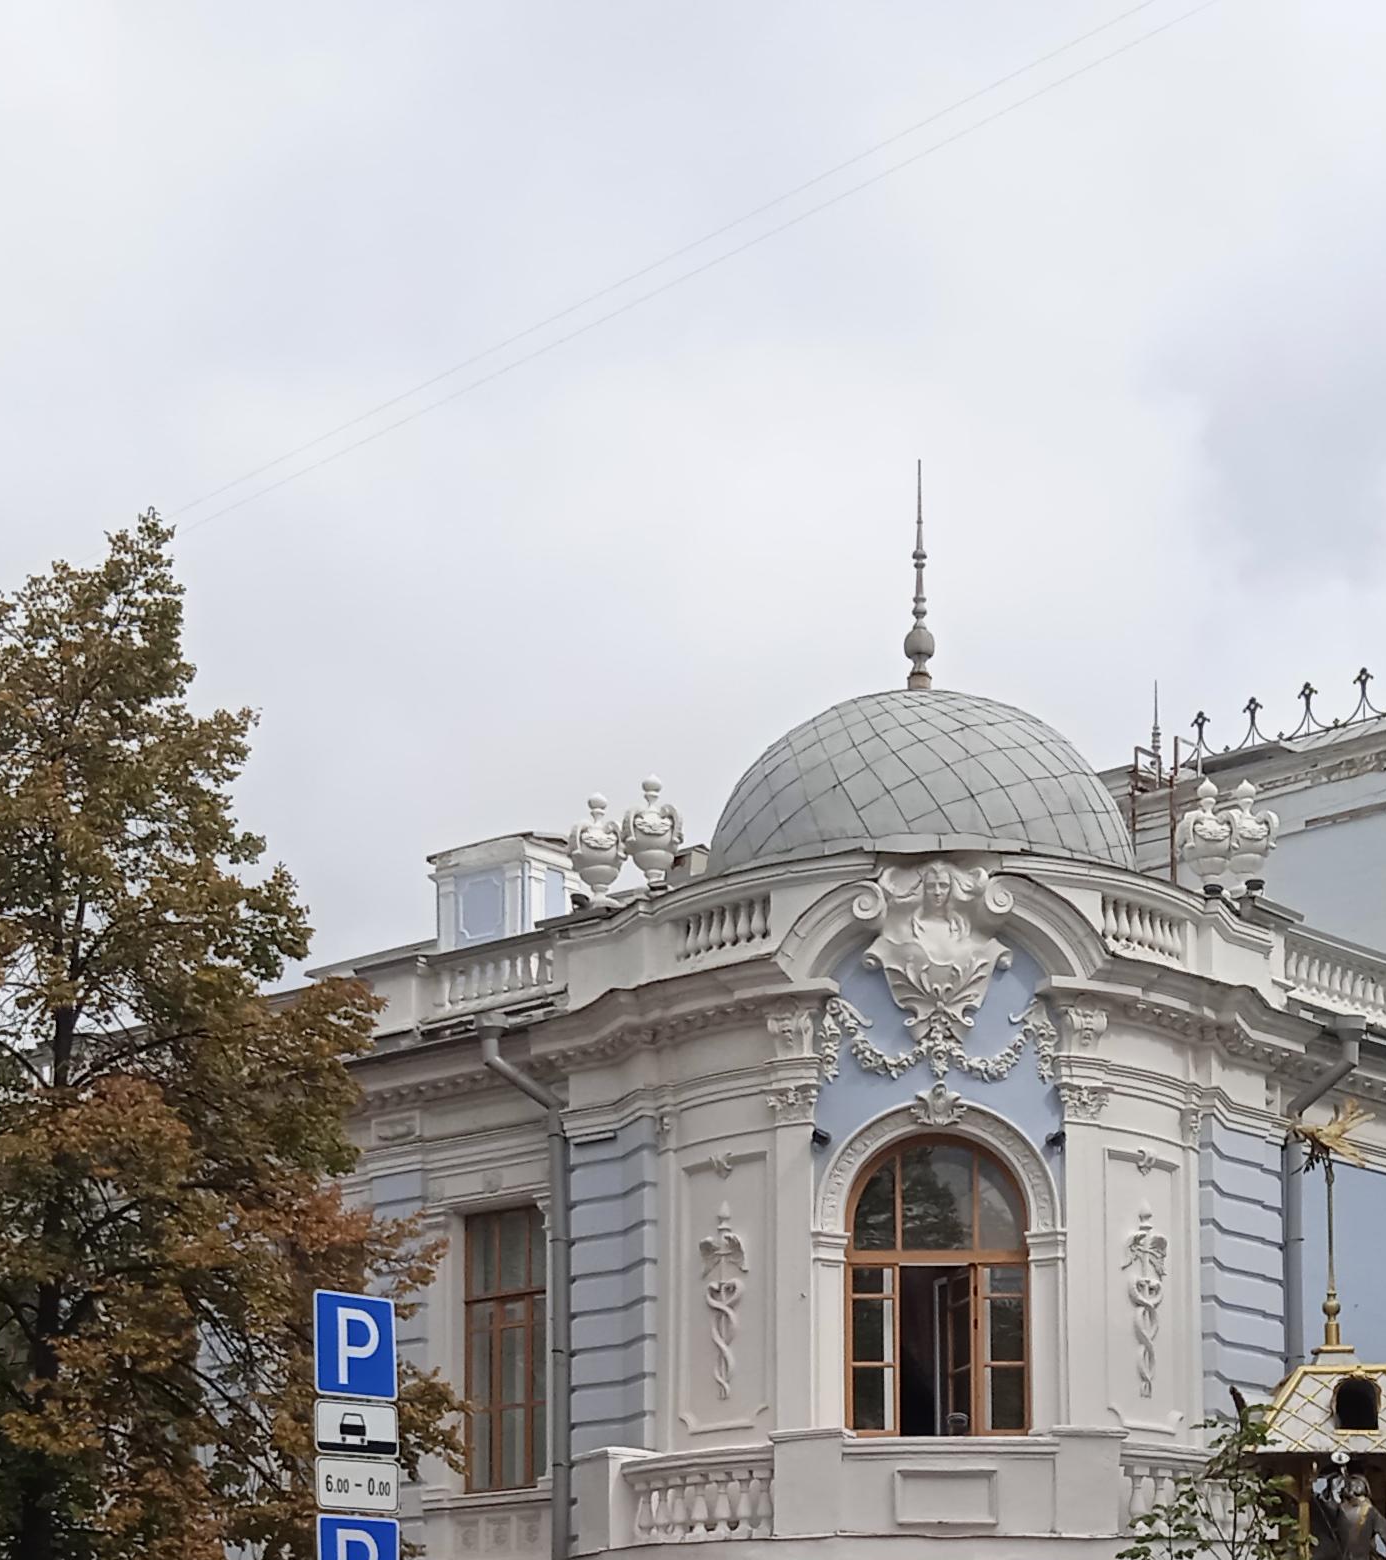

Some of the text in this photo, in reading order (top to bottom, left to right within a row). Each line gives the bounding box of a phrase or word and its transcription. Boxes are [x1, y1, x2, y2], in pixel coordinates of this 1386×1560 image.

[337, 1307, 380, 1385] P
[325, 1473, 350, 1495] 6.00
[367, 1476, 391, 1497] 0.00
